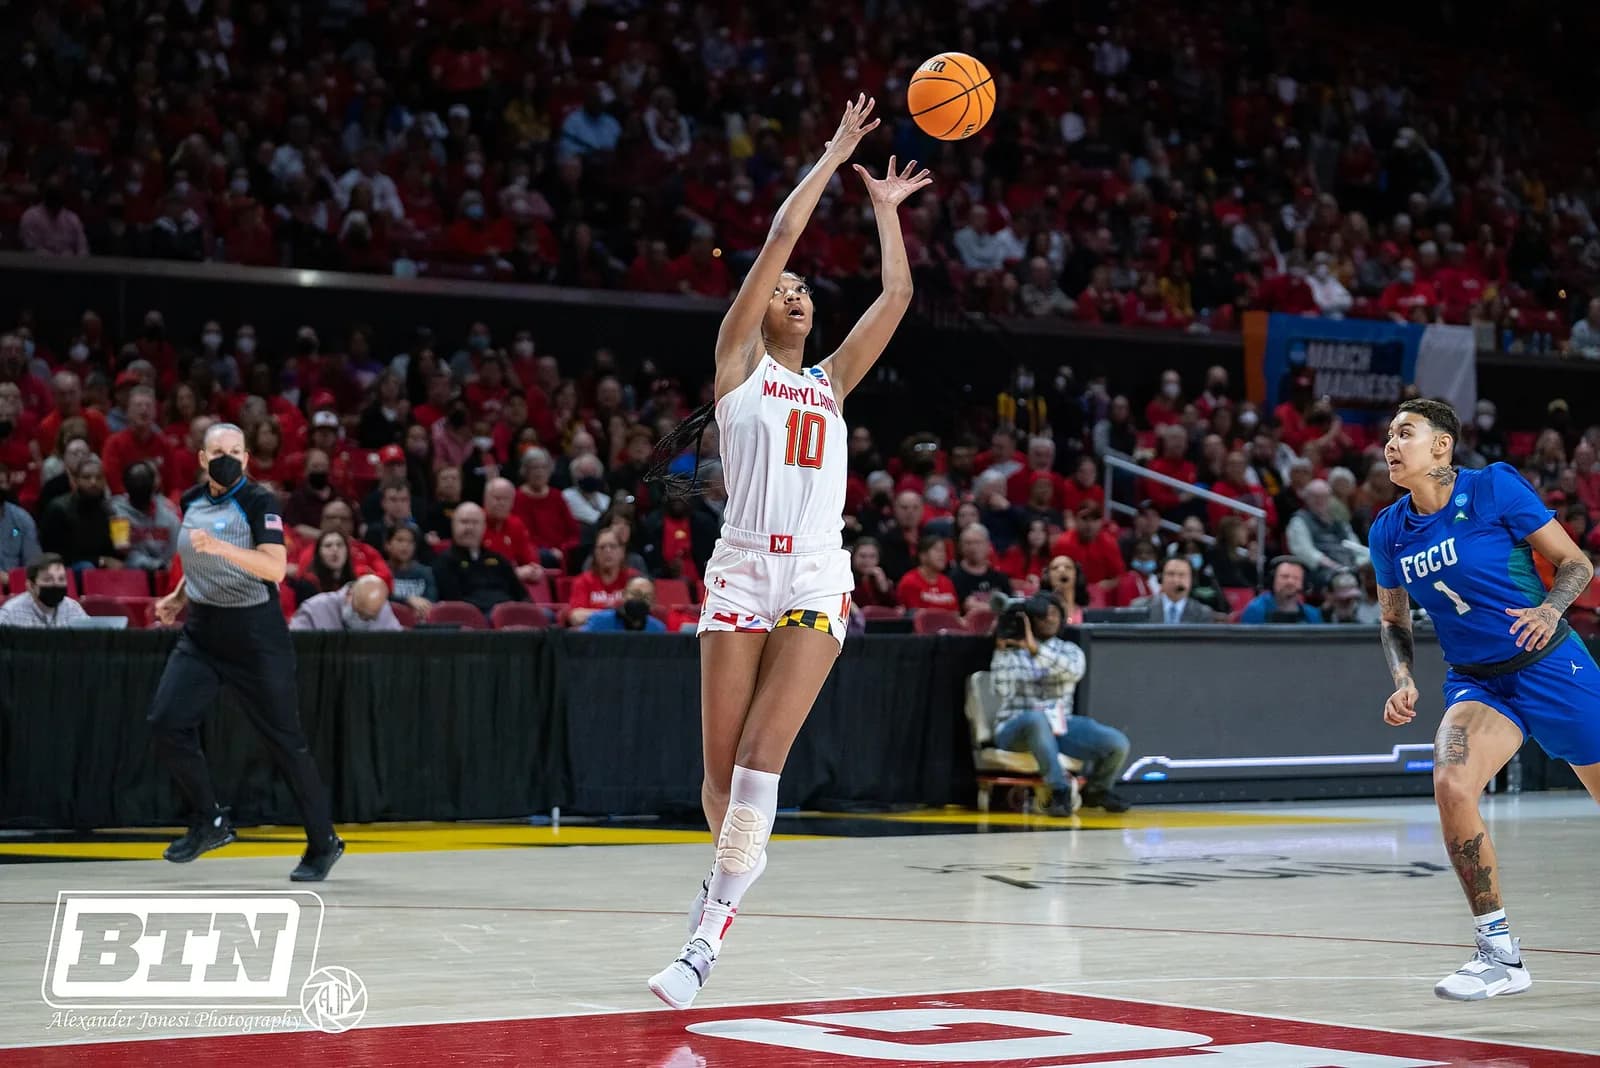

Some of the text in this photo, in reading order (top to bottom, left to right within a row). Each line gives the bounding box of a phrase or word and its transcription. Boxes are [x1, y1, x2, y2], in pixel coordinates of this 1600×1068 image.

[785, 409, 826, 470] 10
[774, 537, 788, 551] M
[1400, 537, 1458, 584] FGCU
[1432, 580, 1472, 616] 1
